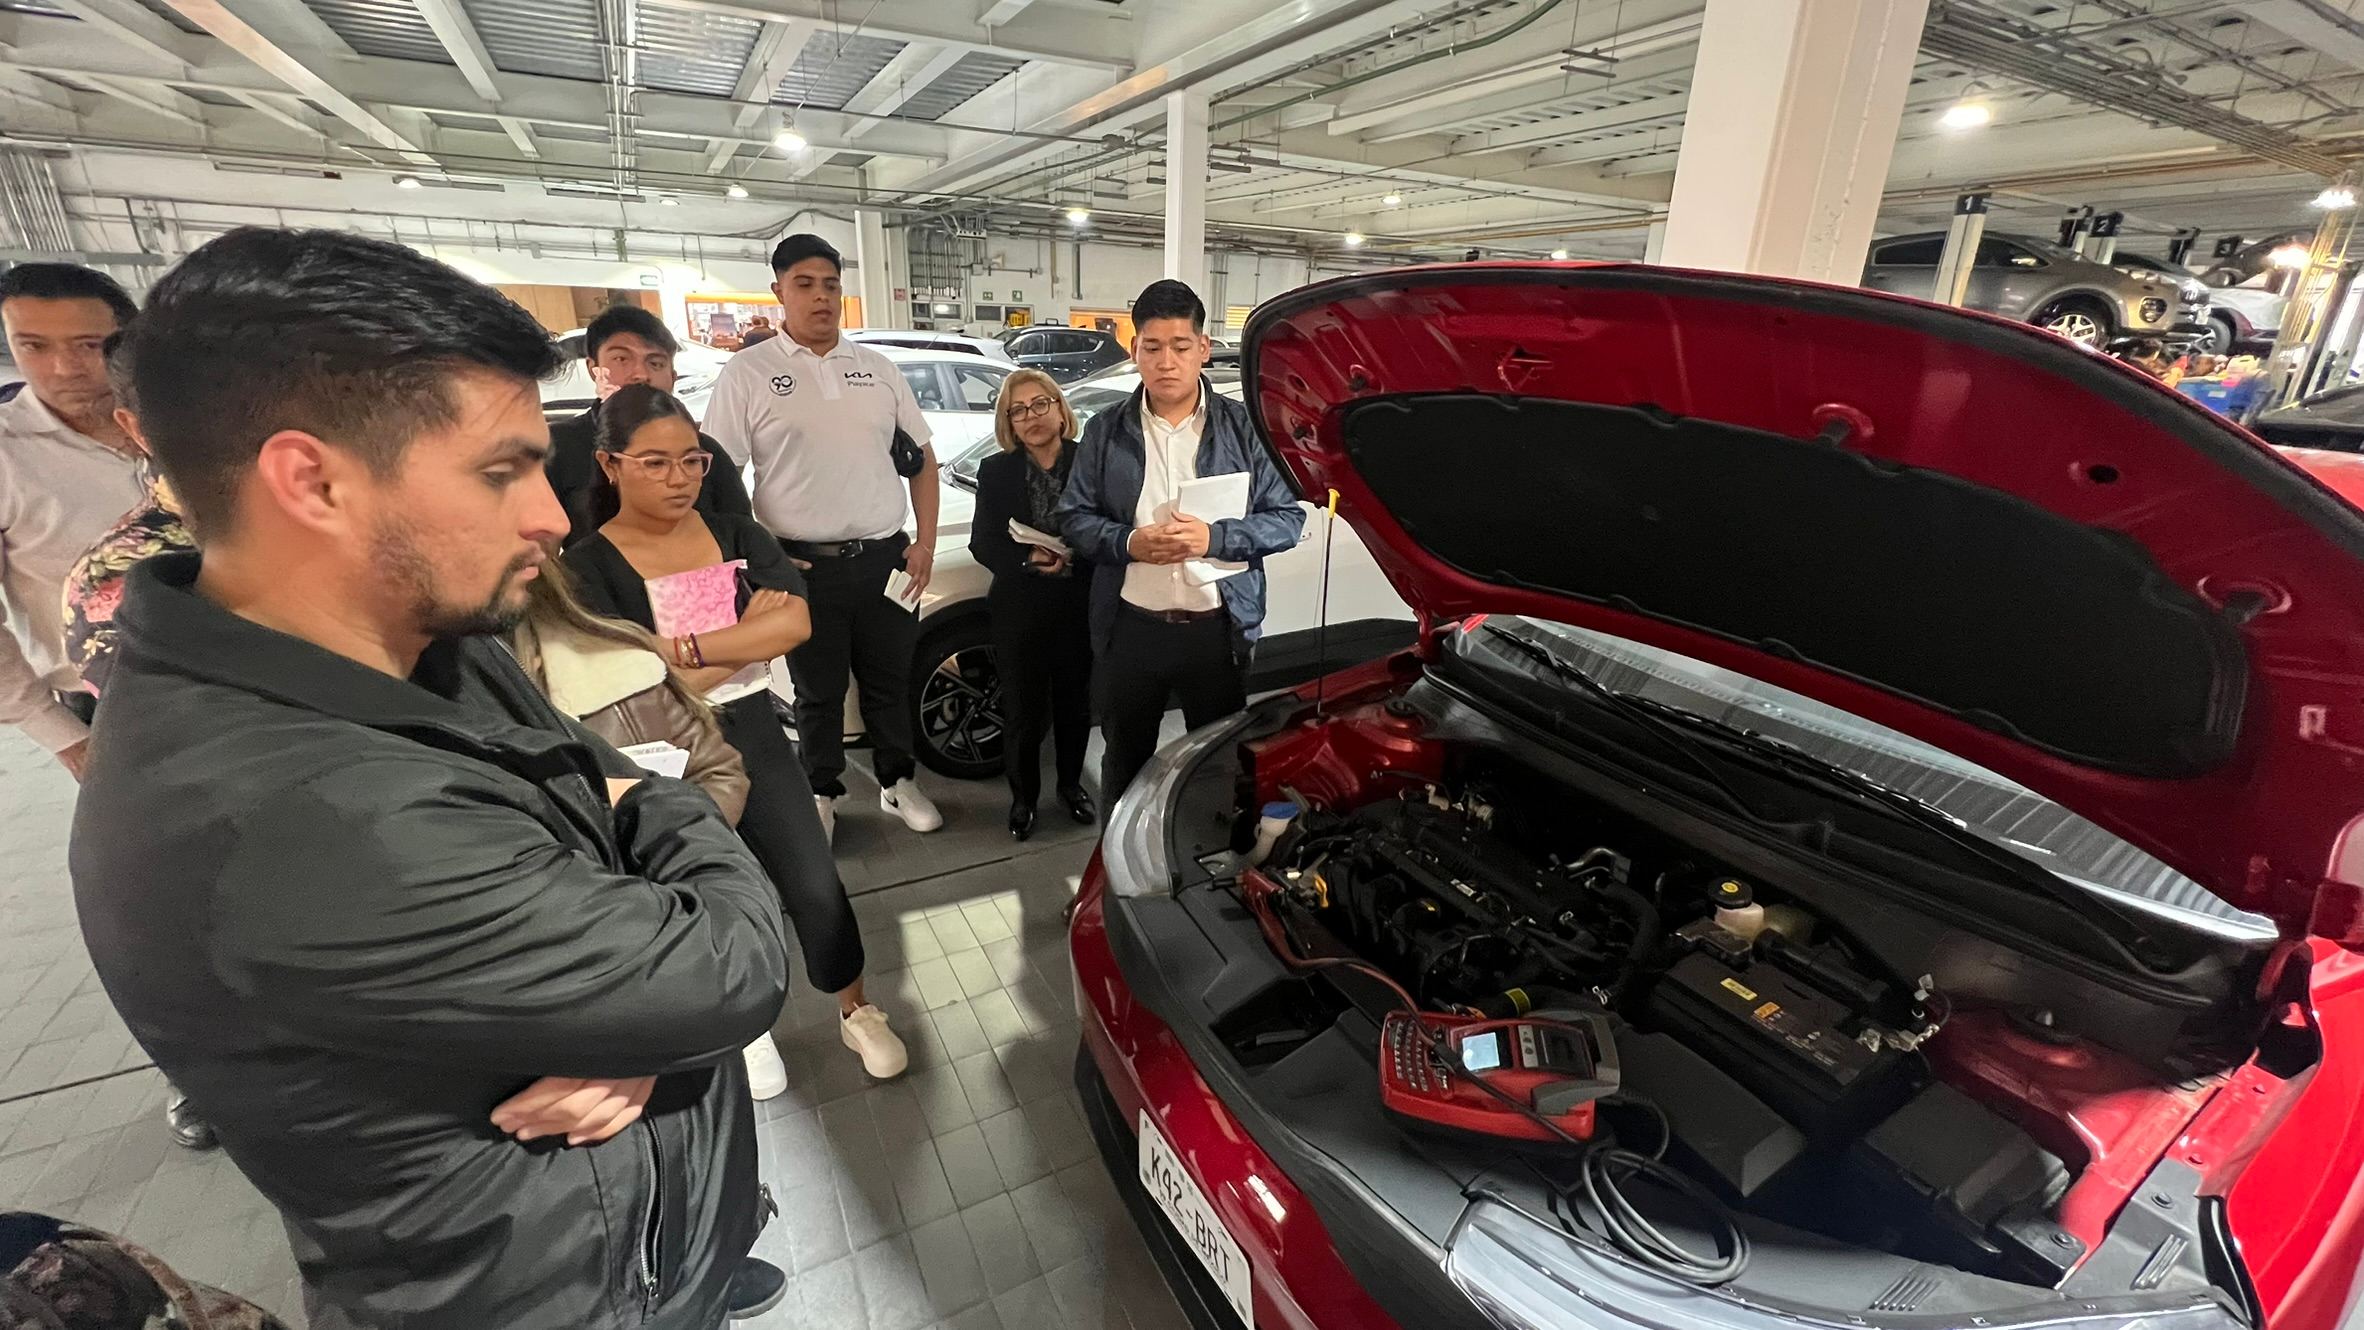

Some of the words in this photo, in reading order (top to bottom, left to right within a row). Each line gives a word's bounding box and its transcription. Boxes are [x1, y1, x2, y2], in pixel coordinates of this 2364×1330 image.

[1965, 195, 1973, 210] 1
[2097, 218, 2109, 232] 2
[1151, 1146, 1230, 1282] K42-BRT
